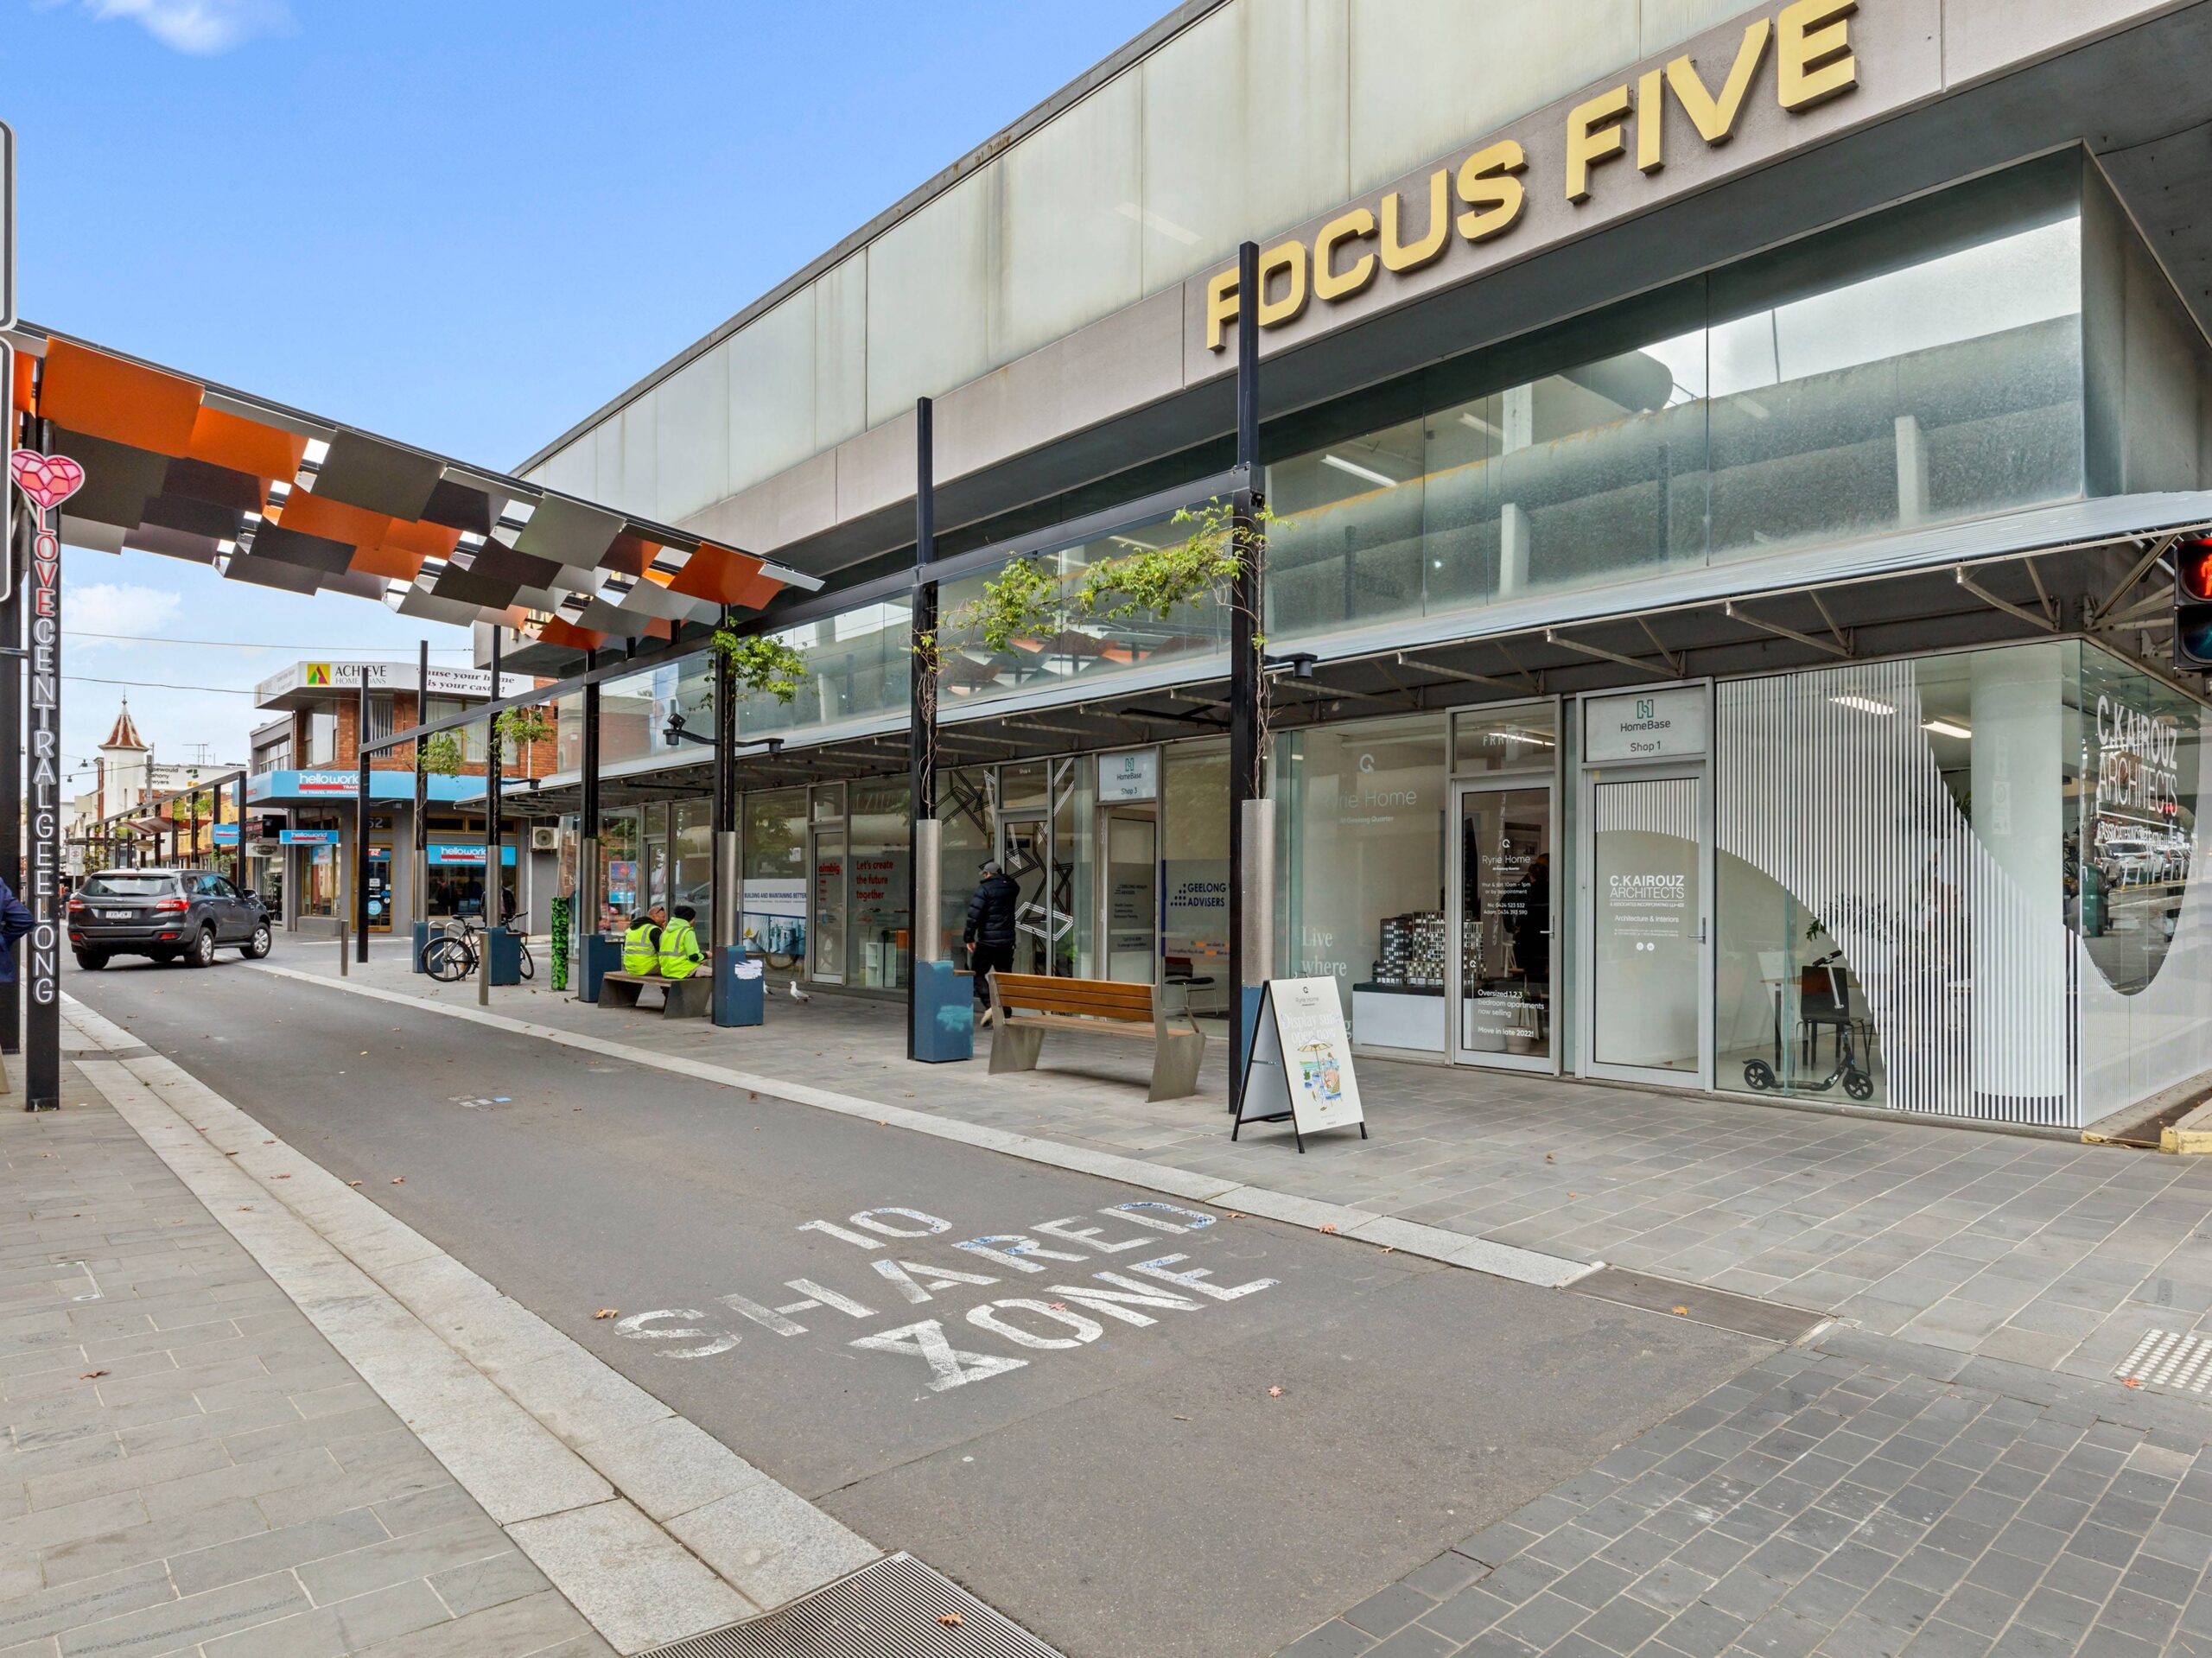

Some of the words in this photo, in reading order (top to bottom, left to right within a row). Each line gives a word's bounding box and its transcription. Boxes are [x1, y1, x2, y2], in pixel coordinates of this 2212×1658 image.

[1207, 139, 1529, 352] FOCUS
[1566, 0, 1860, 205] FIVE
[36, 507, 57, 616] LOVE
[335, 664, 387, 677] ACHIEVE
[33, 618, 56, 810] CENTRAL
[1620, 720, 1671, 732] HomeBase
[2097, 695, 2177, 770] C.KAIROUZ
[1630, 742, 1655, 753] Shop
[1656, 740, 1661, 750] 1
[1116, 772, 1142, 781] HomeBase
[2097, 752, 2178, 817] ARCHITECTS
[1365, 790, 1417, 807] Home
[856, 861, 871, 870] Let's
[873, 861, 893, 870] create
[1482, 855, 1503, 867] Ryrie
[1504, 854, 1531, 864] Home
[856, 874, 867, 884] the
[868, 873, 888, 884] future
[1610, 874, 1685, 886] C.KAIROUZ
[1187, 883, 1227, 893] GEELONG
[1610, 886, 1685, 899] ARCHITECTS
[856, 889, 885, 902] together
[33, 813, 56, 1005] GEELONG
[1187, 898, 1225, 907] ADVISERS
[1302, 926, 1333, 947] Live
[1302, 955, 1347, 976] where
[1478, 989, 1508, 998] Oversized
[1478, 999, 1506, 1007] bedroom
[1507, 1001, 1545, 1010] apartments
[1492, 1009, 1512, 1018] selling
[1281, 1011, 1318, 1031] Display
[1291, 1029, 1314, 1045] open
[1316, 1027, 1337, 1041] now
[1478, 1026, 1495, 1035] Move
[1503, 1027, 1516, 1036] late
[1516, 1029, 1535, 1038] 2022!
[795, 1207, 953, 1249] 10
[613, 1202, 1217, 1359] SHARED
[847, 1253, 1282, 1393] ZONE
